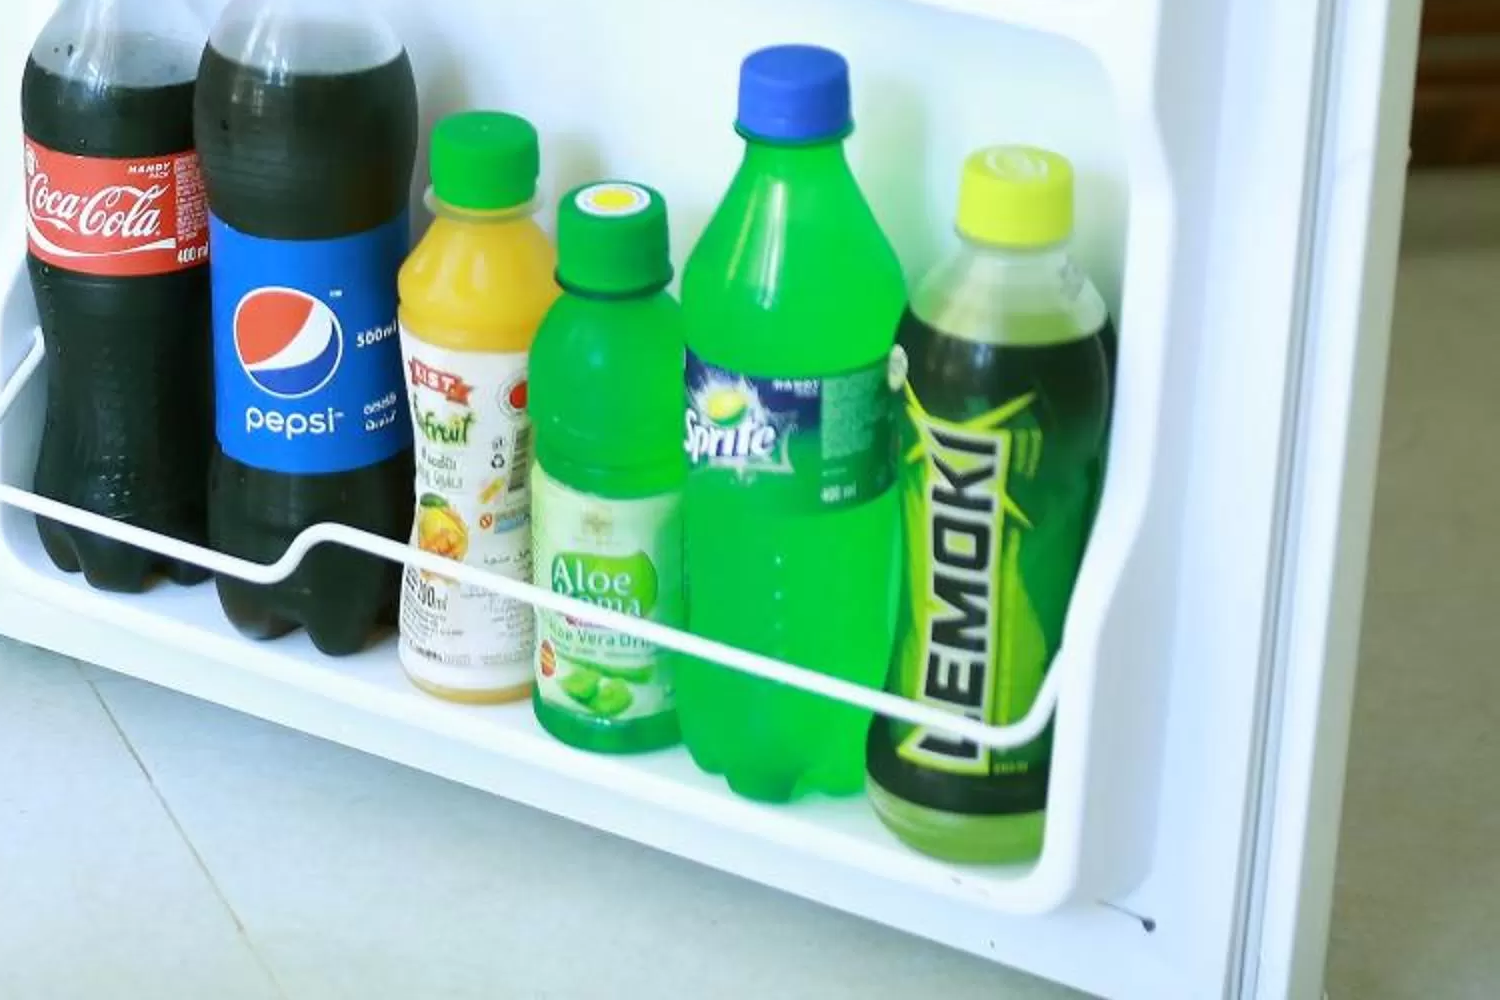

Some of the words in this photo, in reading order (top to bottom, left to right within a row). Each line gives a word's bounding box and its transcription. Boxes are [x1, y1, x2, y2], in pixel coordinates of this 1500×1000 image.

[128, 161, 171, 175] HANDY
[245, 406, 335, 441] pepsi
[683, 407, 778, 465] Sprite
[552, 556, 633, 597] Aloe
